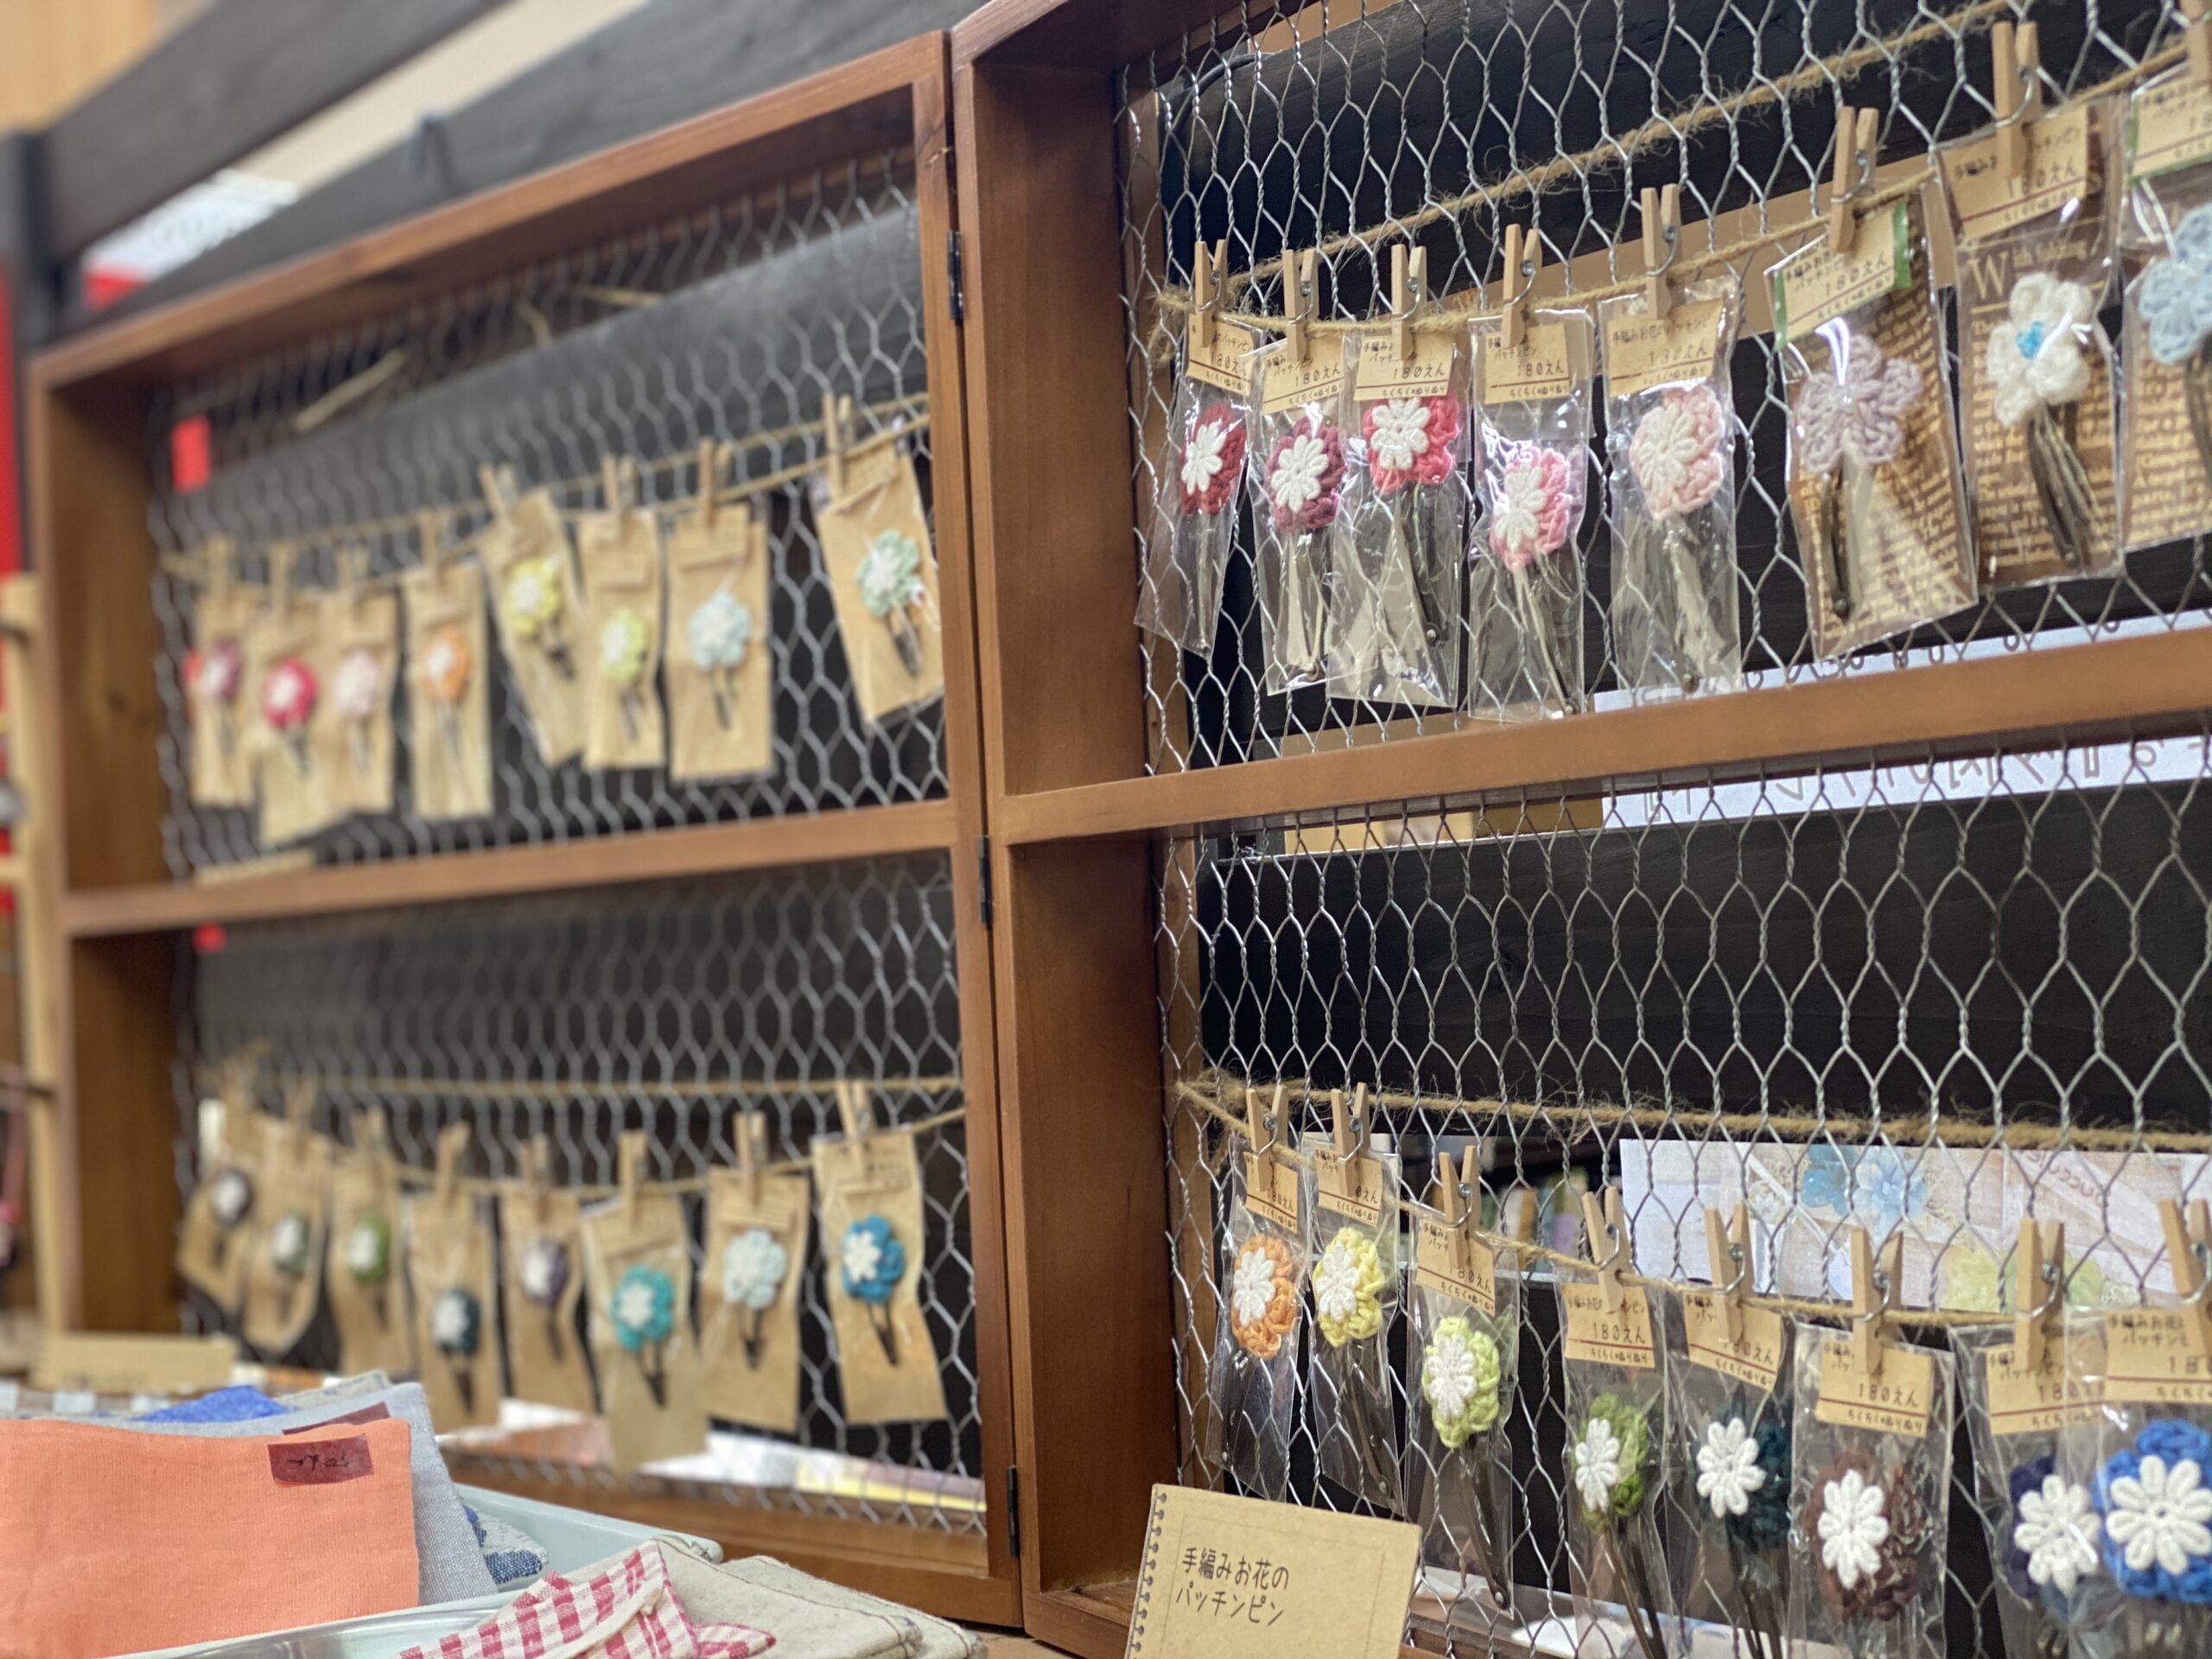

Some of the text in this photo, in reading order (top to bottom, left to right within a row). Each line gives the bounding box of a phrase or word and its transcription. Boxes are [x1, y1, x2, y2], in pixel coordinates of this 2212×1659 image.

[1826, 251, 1887, 296] 180えん
[1295, 362, 1341, 387] 180えん
[1393, 362, 1445, 379] 180えん
[1517, 359, 1564, 378] 180えん
[1267, 1187, 1295, 1212] 180えん
[1355, 1185, 1378, 1205] 0えん
[1450, 1267, 1492, 1294] 180えん
[1593, 1323, 1646, 1344] 180えん
[1859, 1382, 1920, 1408] 180えん
[1182, 1547, 1289, 1591] 手編みお花の
[1176, 1580, 1284, 1626] パッチンピン
